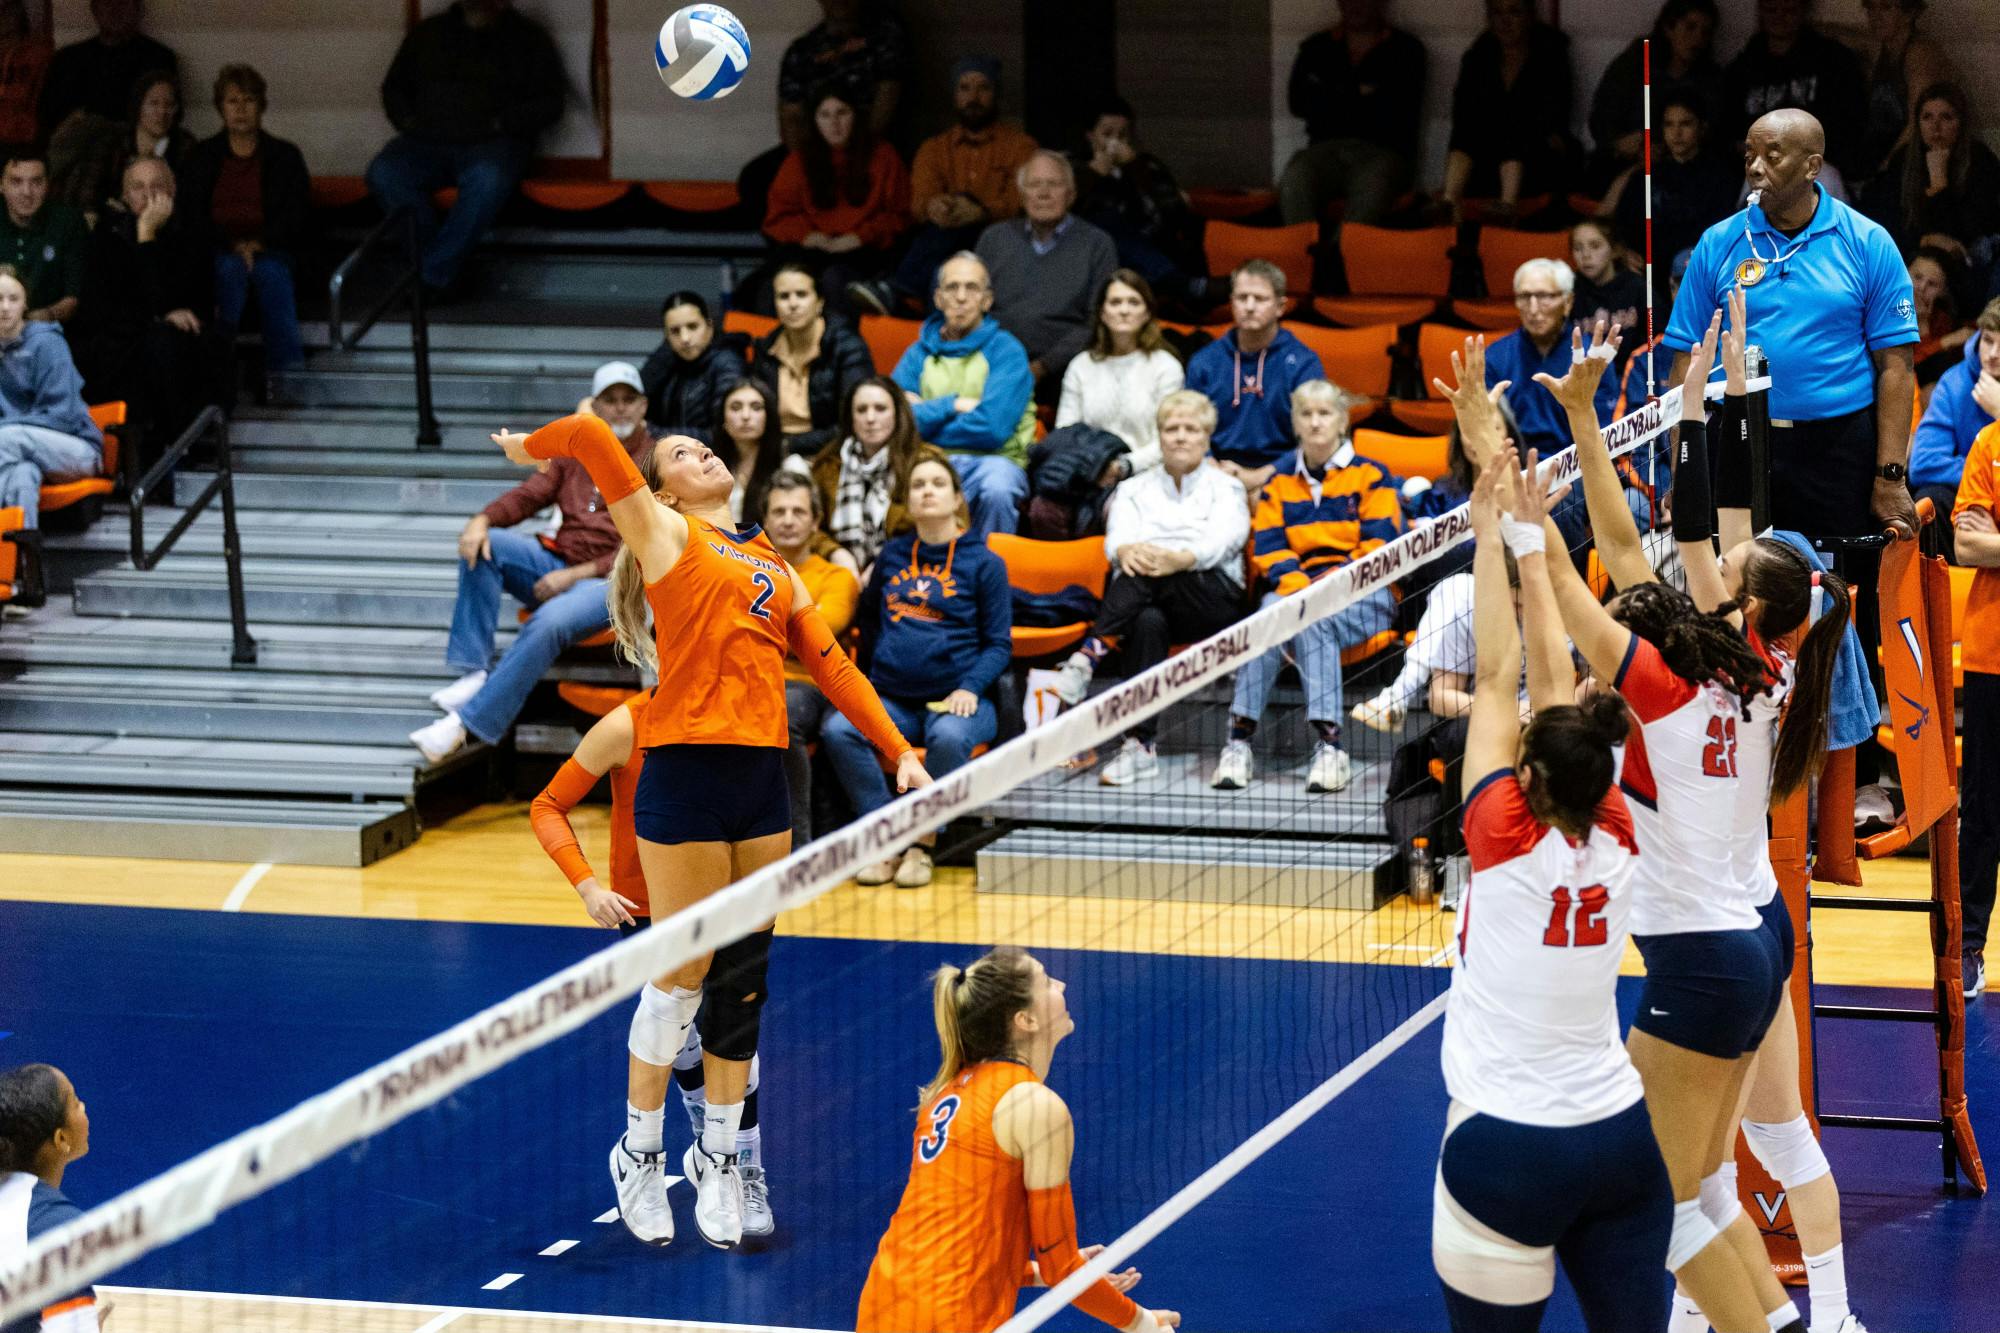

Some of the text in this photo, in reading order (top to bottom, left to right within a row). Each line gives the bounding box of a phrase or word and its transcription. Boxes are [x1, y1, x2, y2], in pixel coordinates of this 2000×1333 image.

[1350, 508, 1472, 593] VIRGINIA VOLLEYBAL
[748, 571, 776, 621] 2
[1095, 624, 1251, 728] VIRGINIA VOLLEYBALL
[1542, 883, 1610, 948] 12
[919, 1094, 961, 1163] 3
